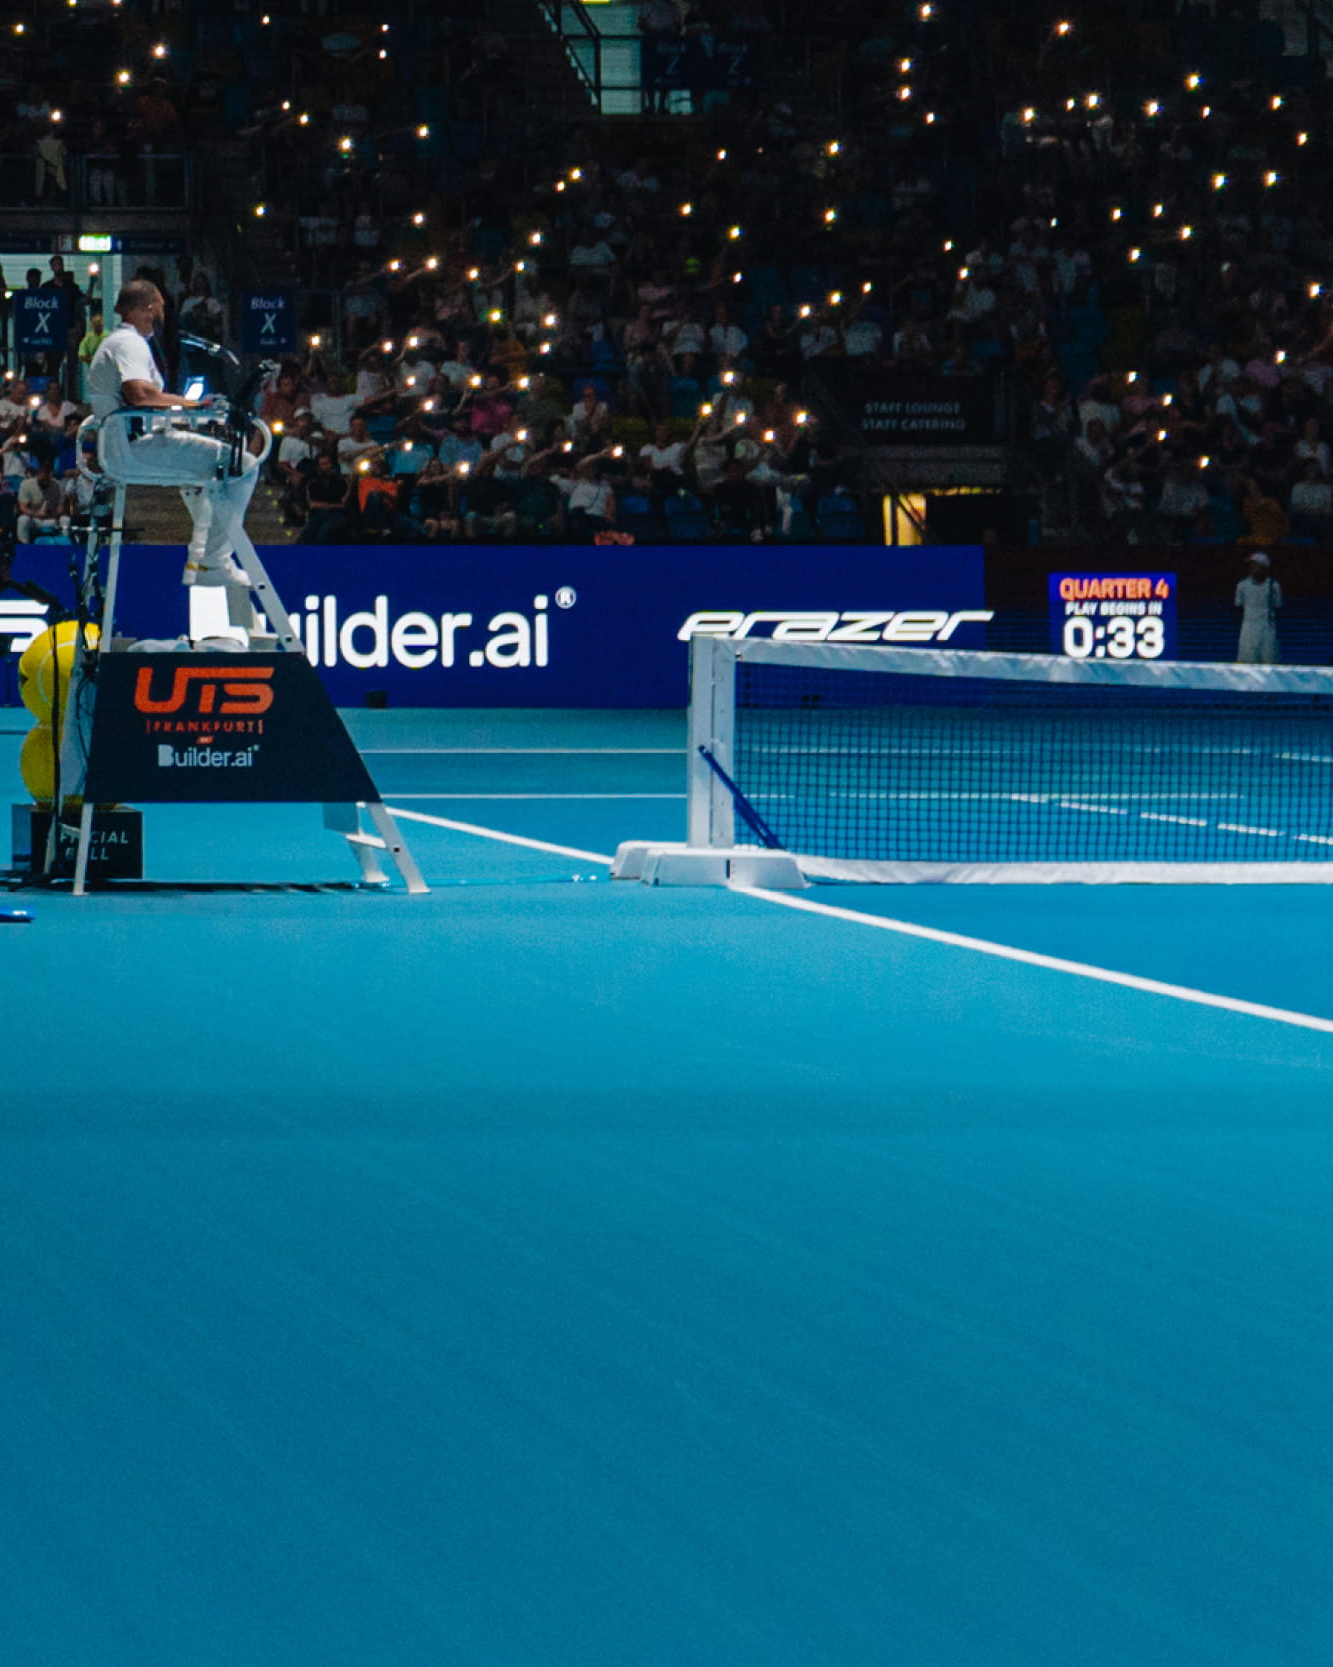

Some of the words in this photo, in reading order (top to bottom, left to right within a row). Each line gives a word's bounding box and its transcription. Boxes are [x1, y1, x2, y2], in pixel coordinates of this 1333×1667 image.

[24, 296, 58, 309] Block
[251, 296, 284, 310] Block
[34, 312, 51, 333] X
[260, 312, 277, 334] X
[1059, 578, 1152, 601] QUARTER
[1154, 578, 1169, 599] 4
[1065, 601, 1098, 615] PLAY
[1100, 601, 1146, 615] BEGINS
[1148, 601, 1162, 615] IN
[677, 610, 994, 641] erazer
[1063, 616, 1165, 659] 0:33
[134, 667, 274, 714] UTS
[153, 721, 254, 732] FRANKFURT
[50, 831, 129, 844] FCIAL
[65, 847, 109, 860] BLL
